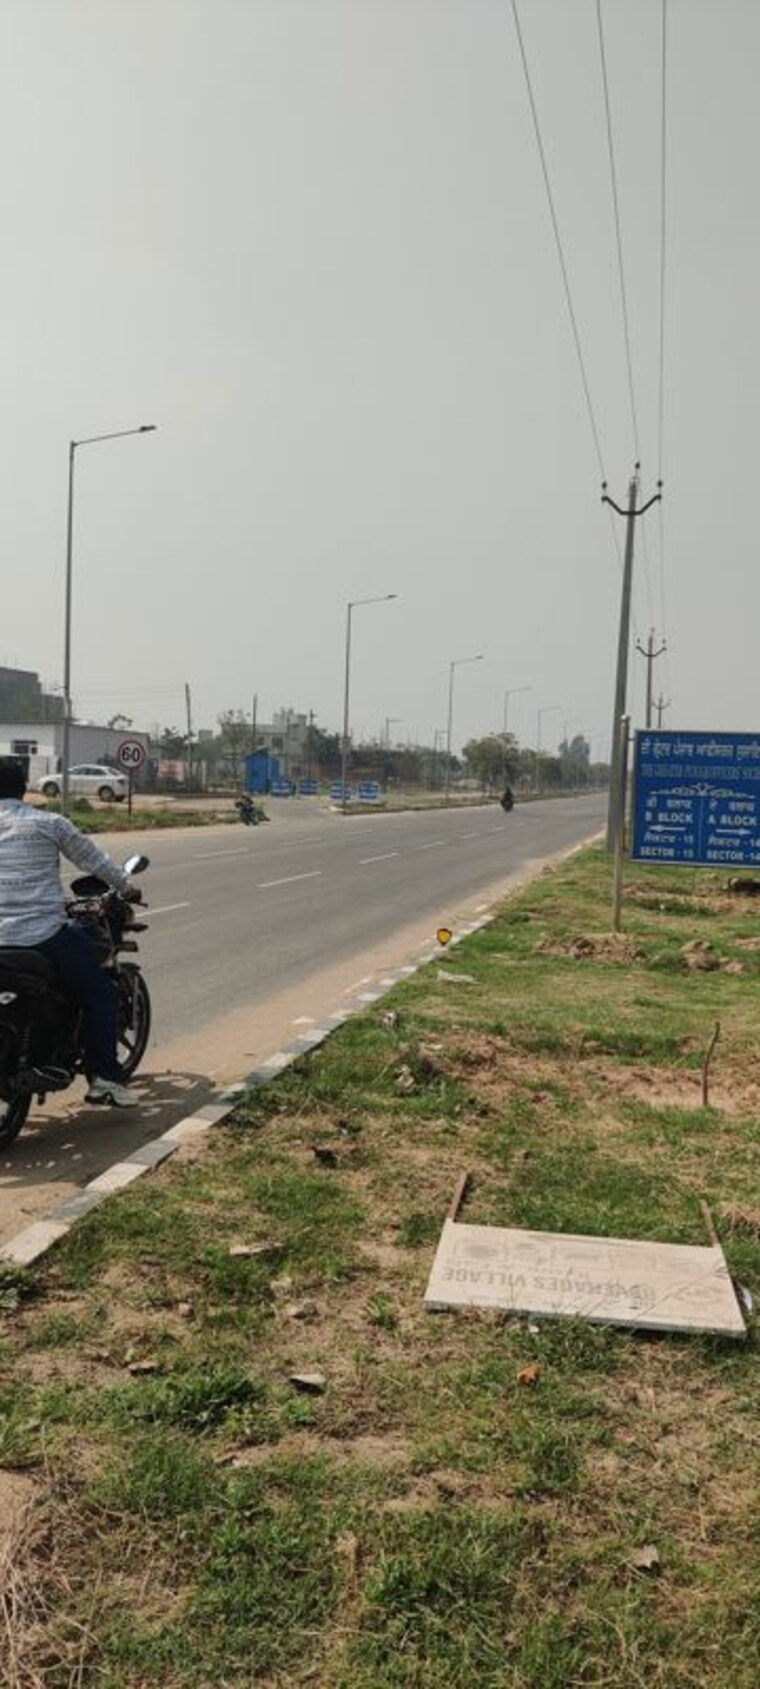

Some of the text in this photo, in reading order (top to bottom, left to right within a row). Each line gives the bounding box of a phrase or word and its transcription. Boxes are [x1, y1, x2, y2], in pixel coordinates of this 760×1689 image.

[122, 747, 140, 762] 60
[645, 811, 693, 824] B BLOCK
[708, 814, 757, 826] A BLOCK
[640, 846, 674, 857] SECTOR
[707, 850, 744, 860] SECTOR
[443, 1268, 525, 1287] VILLAGE
